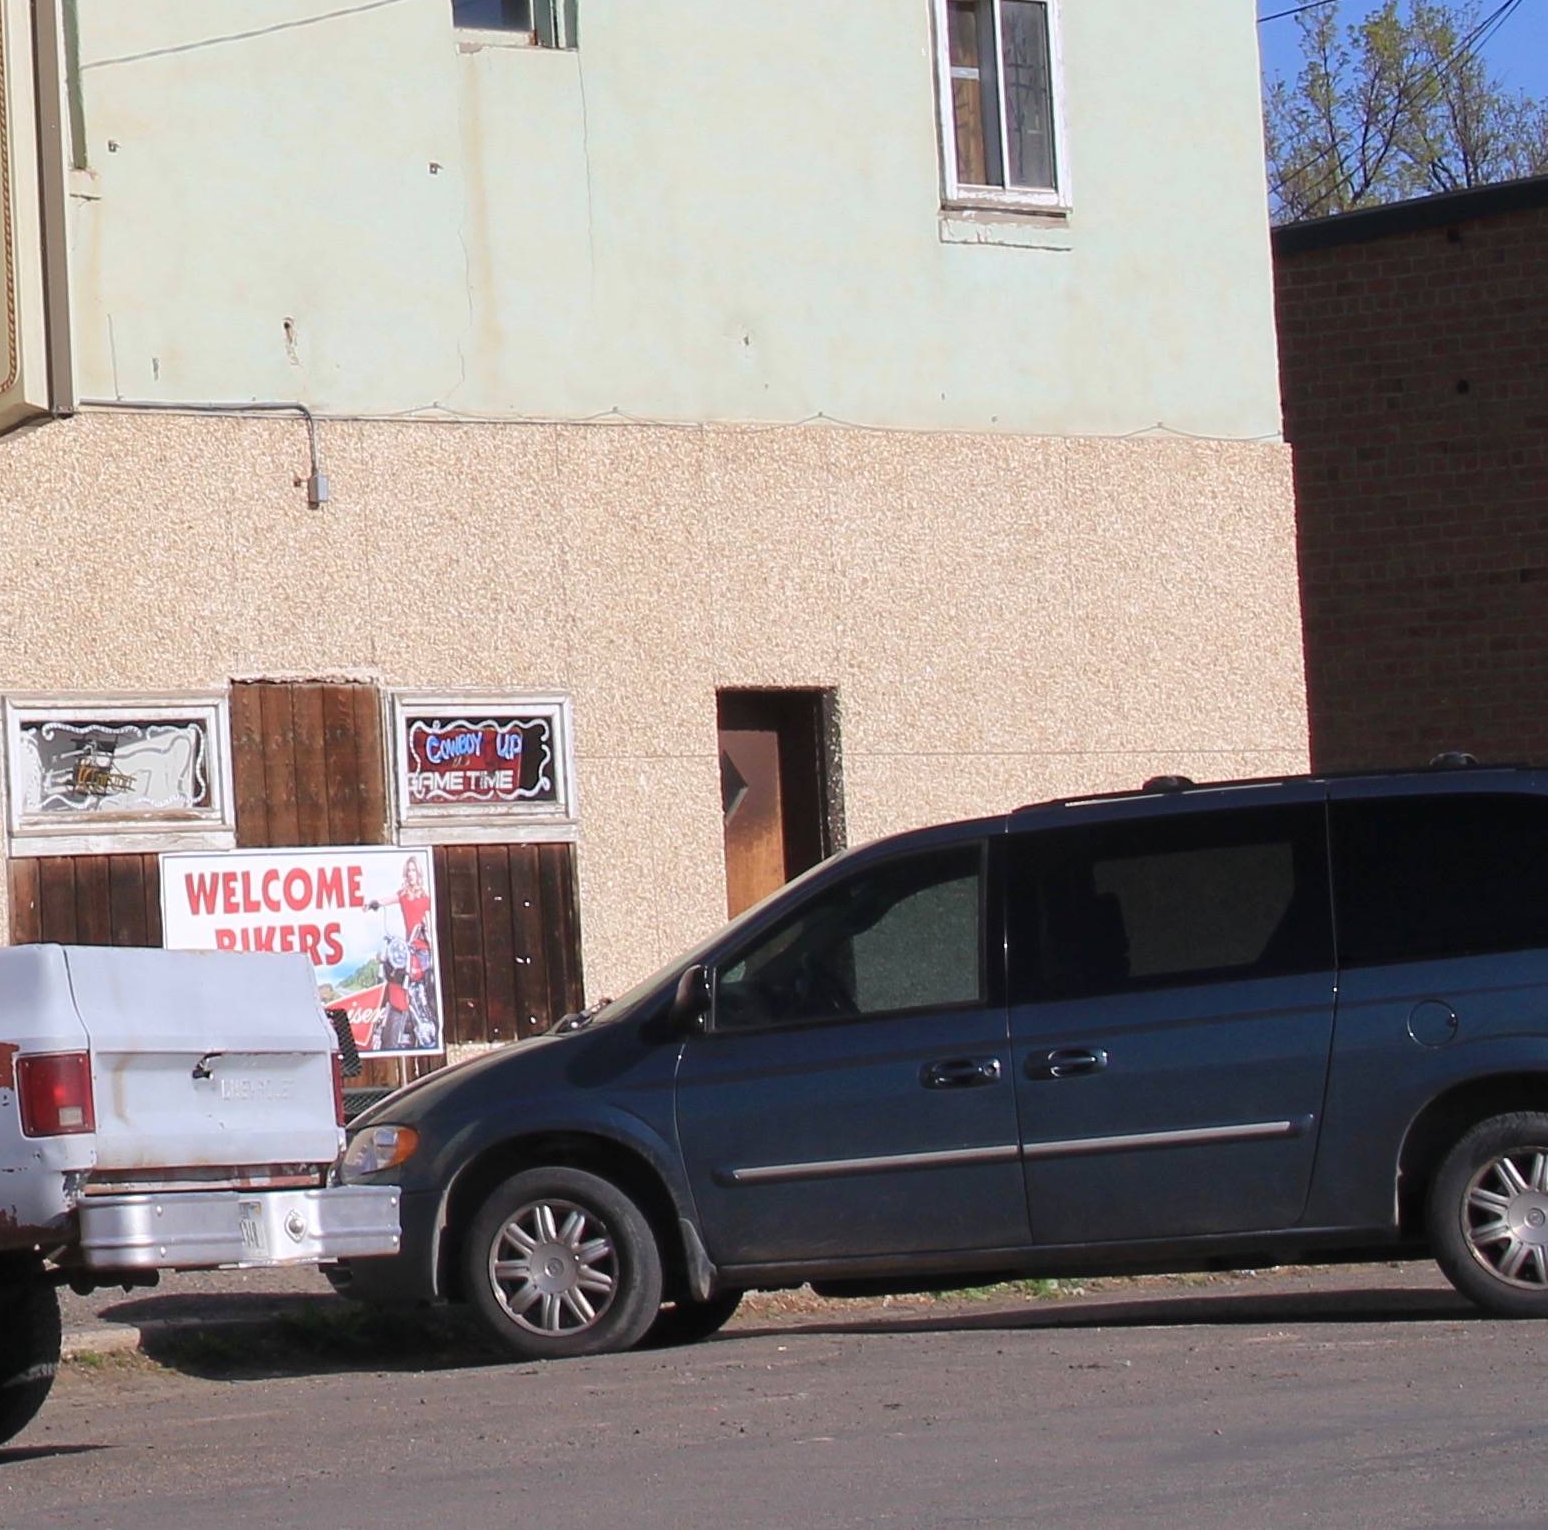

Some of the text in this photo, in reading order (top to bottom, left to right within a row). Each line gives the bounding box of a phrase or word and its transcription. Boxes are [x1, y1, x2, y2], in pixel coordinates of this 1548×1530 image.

[426, 731, 483, 764] COWBOY
[496, 733, 523, 760] UP
[184, 865, 365, 916] WELCOME
